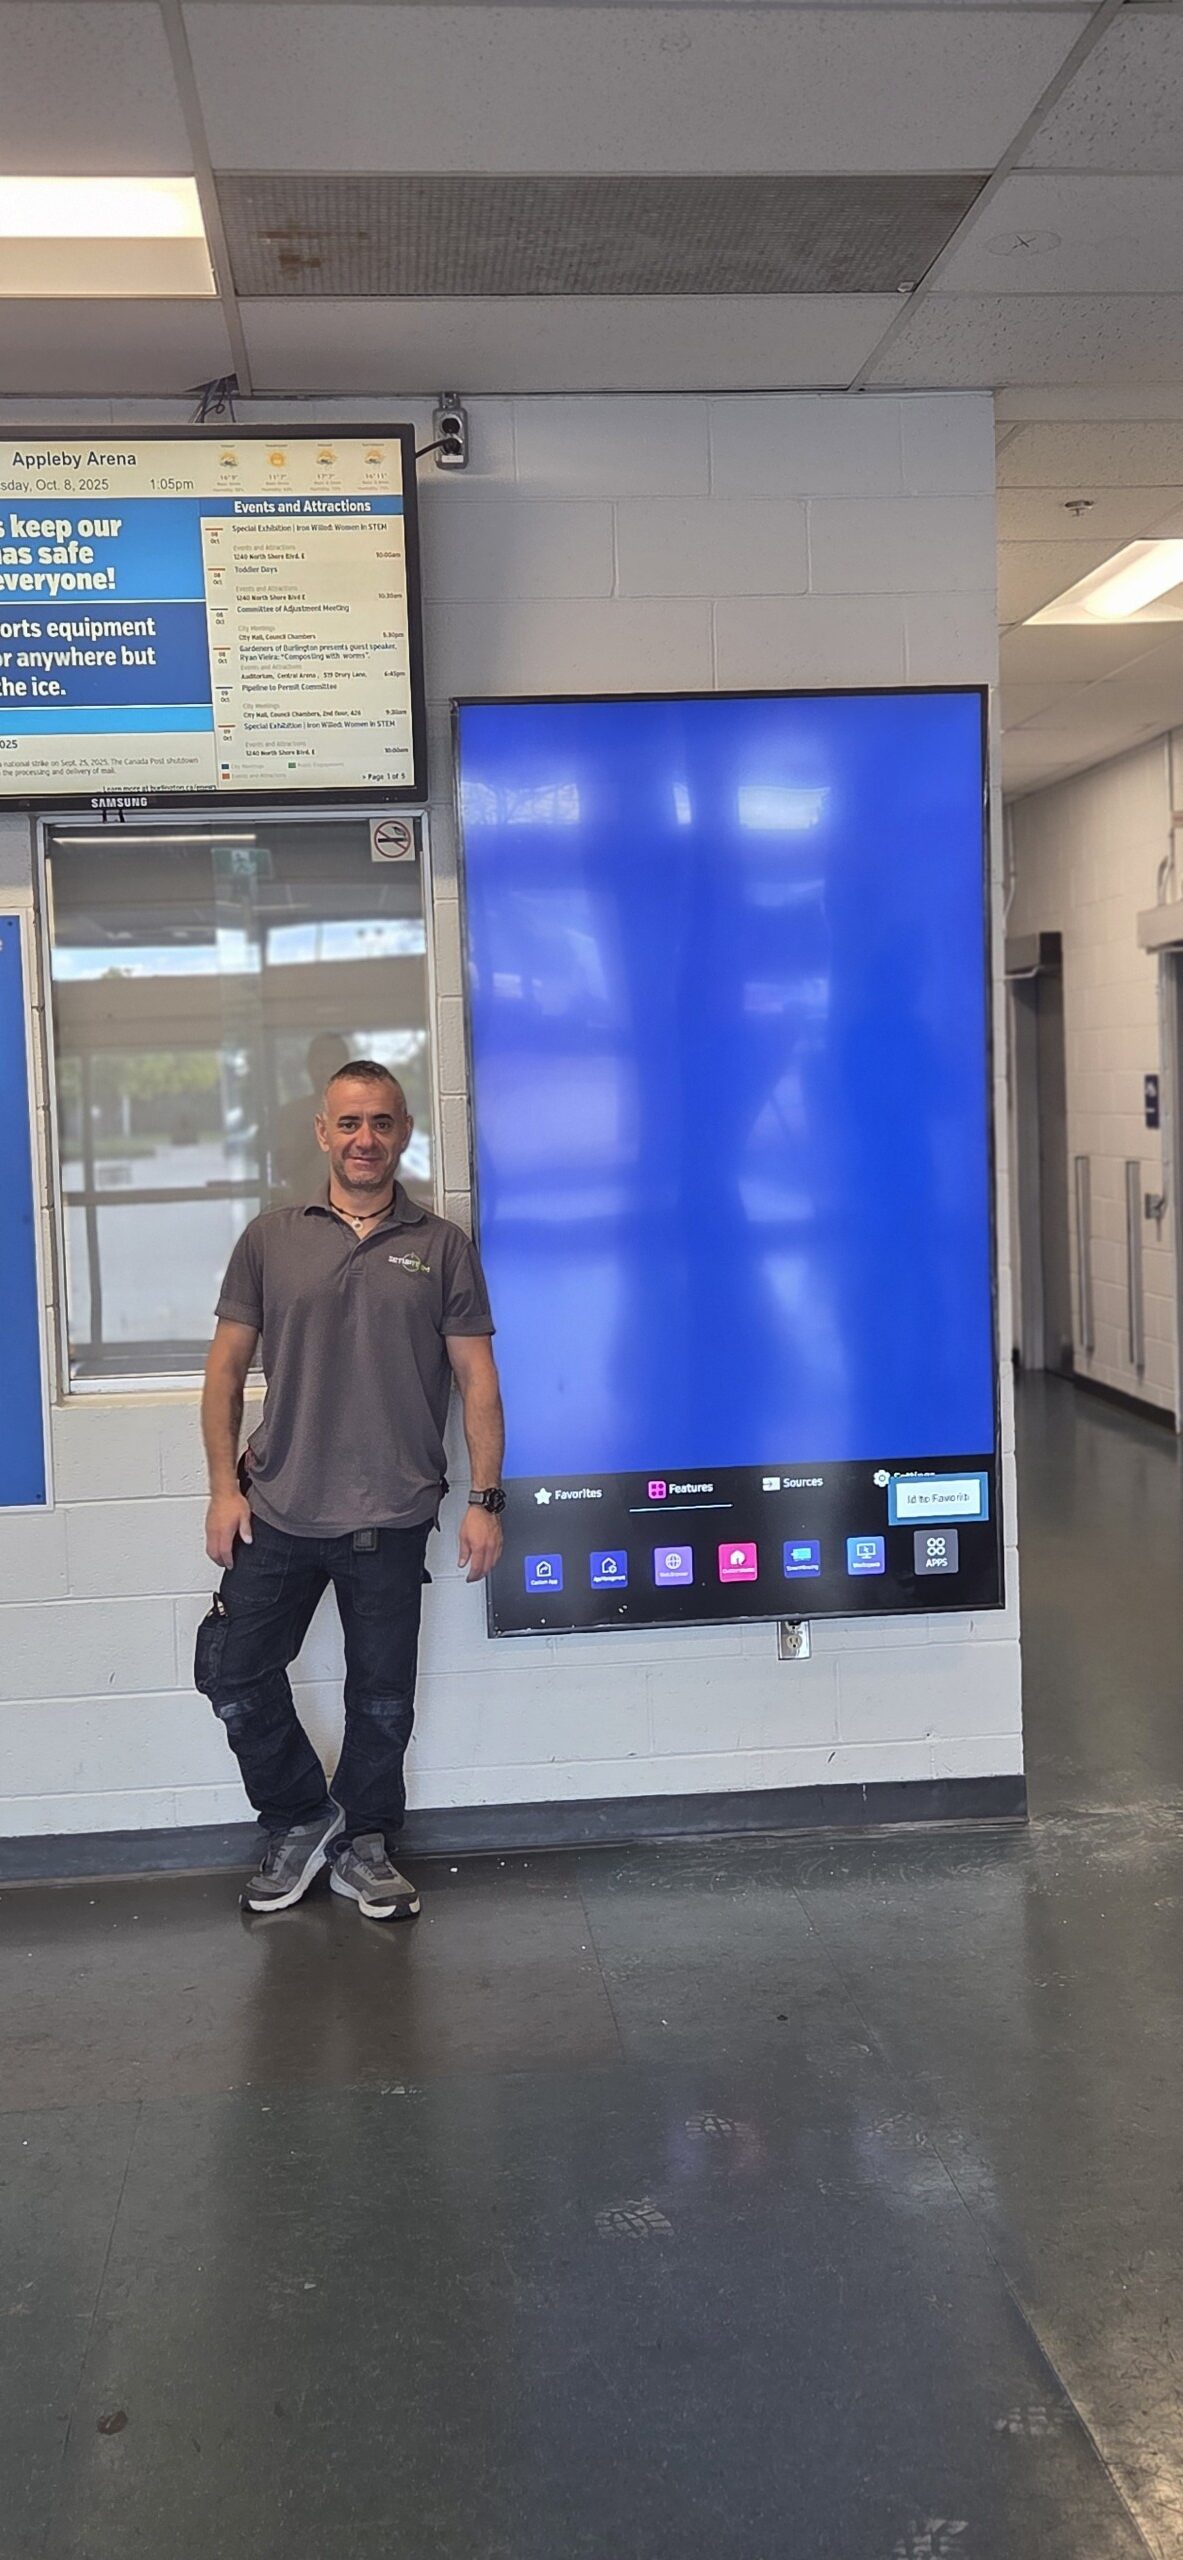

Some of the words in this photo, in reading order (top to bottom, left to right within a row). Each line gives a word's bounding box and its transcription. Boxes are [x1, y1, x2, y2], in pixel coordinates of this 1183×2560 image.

[12, 451, 82, 470] Appleby
[87, 451, 137, 466] Arena
[36, 479, 61, 491] Oct.
[64, 479, 76, 492] 8,
[79, 479, 109, 490] 2025
[150, 478, 194, 492] 1:05pm
[234, 501, 276, 514] Events
[277, 500, 301, 513] and
[303, 499, 371, 512] Attractions
[9, 513, 72, 544] keep
[77, 519, 122, 538] our
[232, 525, 256, 533] Special
[258, 524, 291, 532] Exhibition
[0, 546, 33, 565] as
[38, 540, 94, 565] safe
[261, 566, 278, 574] Days
[283, 605, 321, 614] Adjustment
[323, 605, 349, 613] Meeting
[0, 619, 42, 638] orts
[46, 617, 156, 642] equipment
[240, 644, 273, 652] Gardeners
[284, 644, 318, 652] Burlington
[320, 644, 348, 652] presents
[350, 643, 368, 651] guest
[0, 651, 13, 667] r
[16, 646, 116, 671] anywhere
[121, 646, 156, 666] but
[240, 654, 257, 662] Ryan
[0, 676, 28, 697] he
[31, 676, 67, 697] ice.
[242, 684, 268, 692] Pipeline
[150, 757, 165, 765] Post
[15, 769, 50, 777] processing
[65, 768, 91, 776] delivery
[91, 797, 148, 808] SAMSUNG
[668, 1482, 714, 1494] Features
[782, 1476, 824, 1488] Sources
[554, 1487, 603, 1500] Favorites
[925, 1558, 948, 1568] APPS
